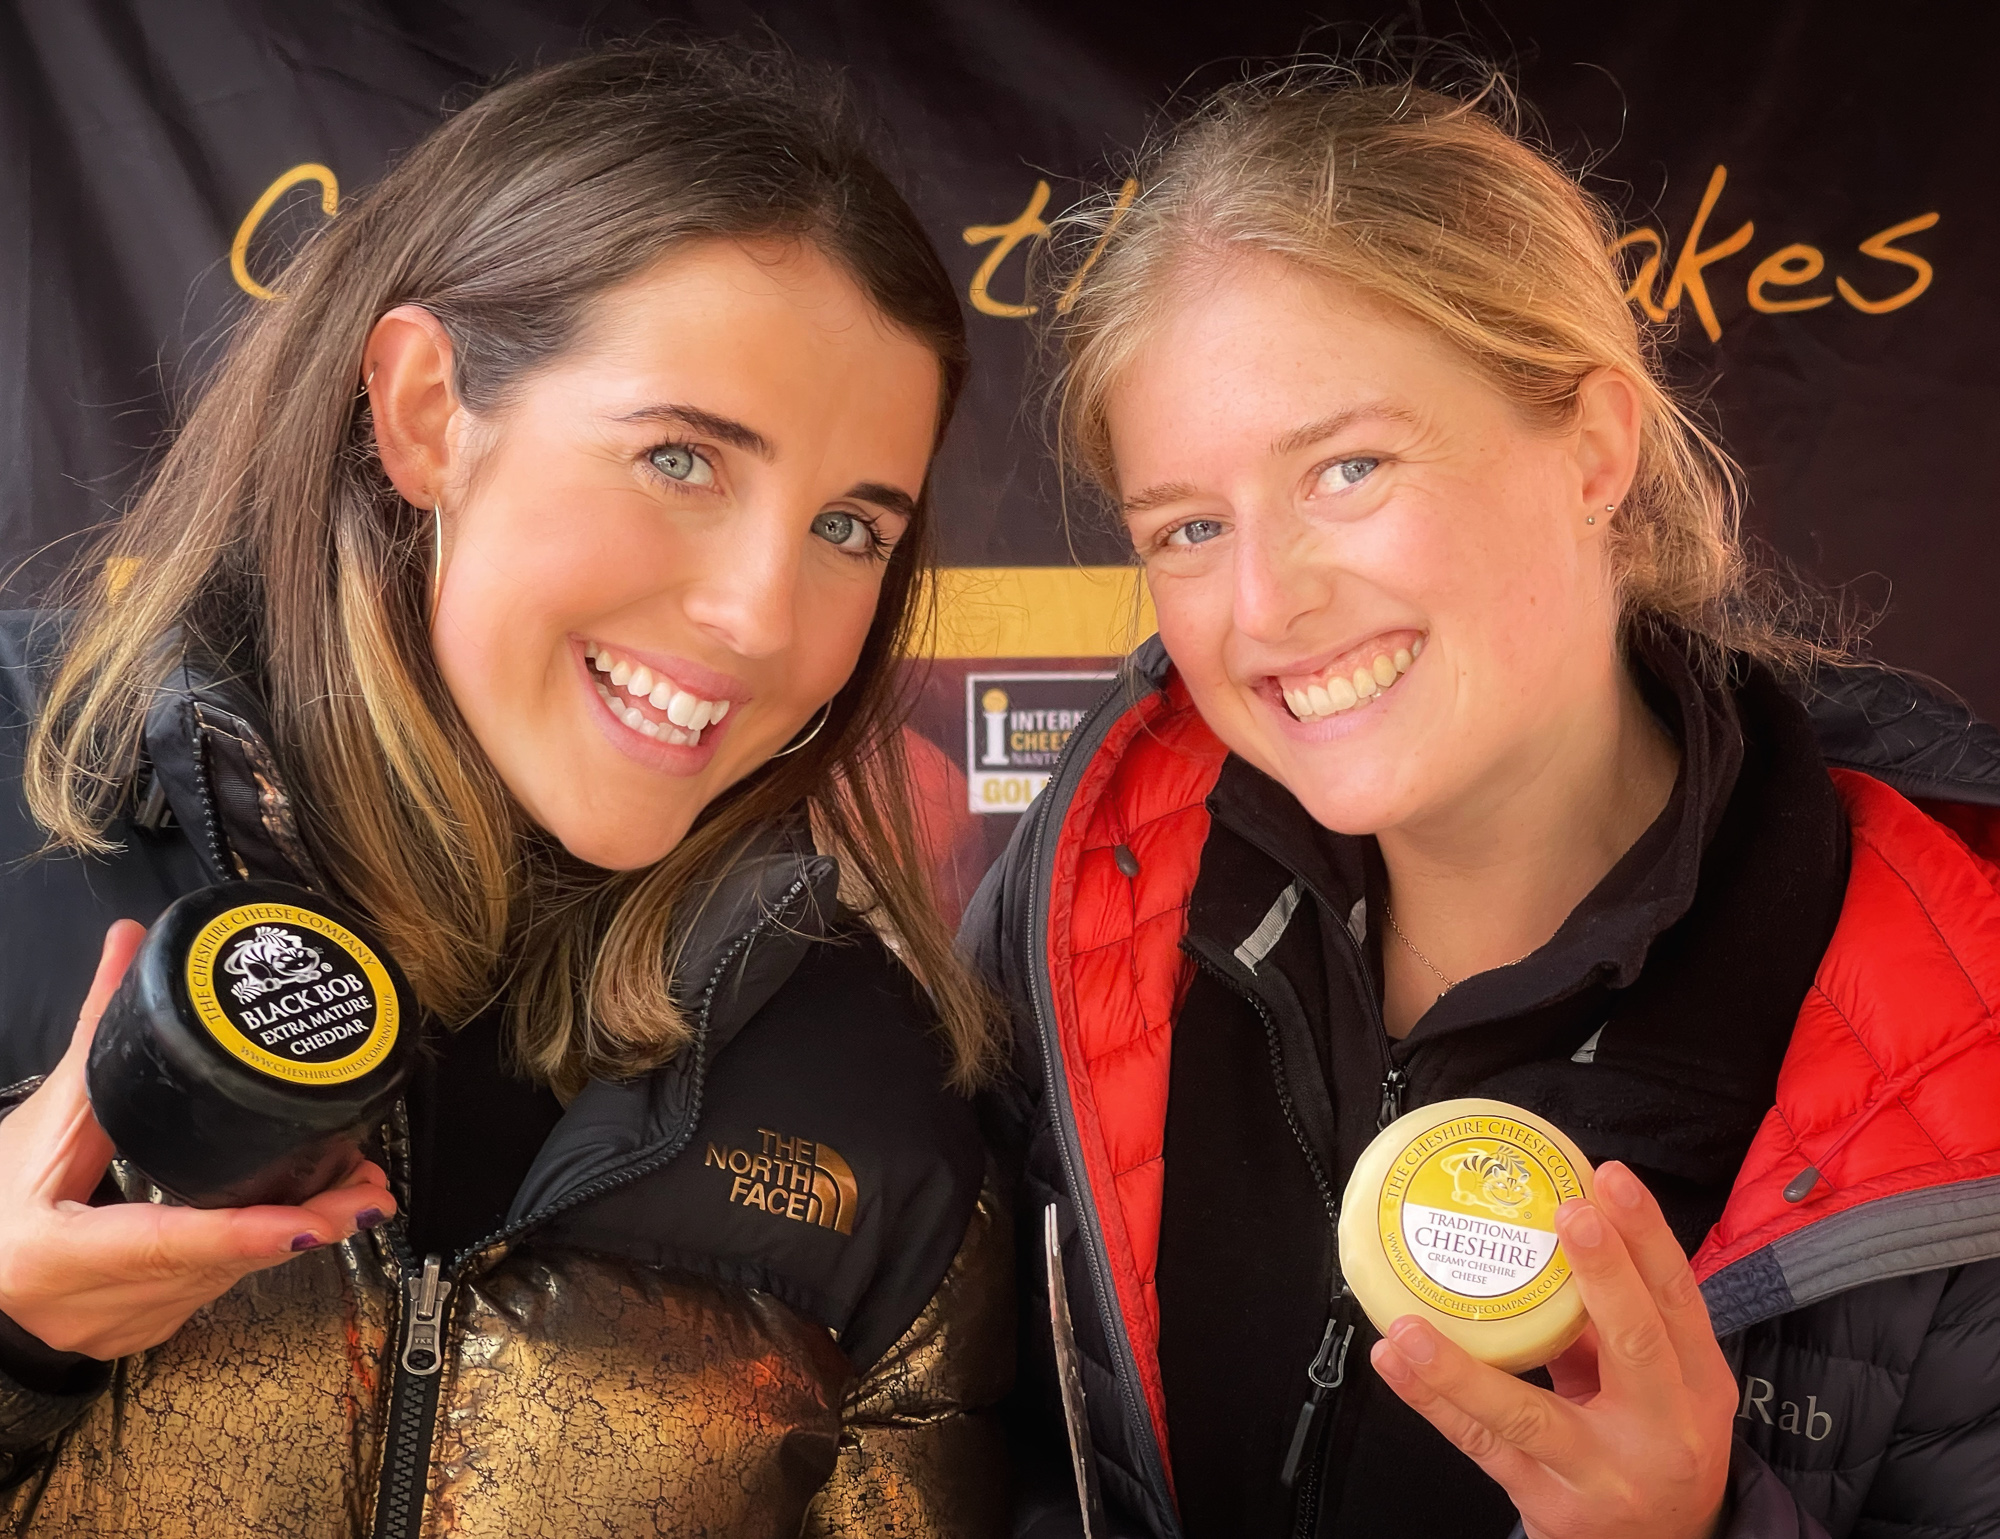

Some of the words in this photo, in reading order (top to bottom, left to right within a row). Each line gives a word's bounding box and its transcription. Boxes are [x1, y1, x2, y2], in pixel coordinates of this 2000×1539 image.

[231, 907, 293, 925] CHEESE
[297, 912, 377, 965] COMPANY
[193, 919, 233, 987] CHESHIRE
[195, 991, 222, 1024] THE
[239, 989, 320, 1030] BLACK
[312, 973, 364, 1003] BOB
[259, 1018, 312, 1046] EXTRA
[308, 995, 373, 1028] MATURE
[289, 1018, 370, 1056] CHEDDAR
[704, 1140, 812, 1194] NORTH
[757, 1127, 814, 1166] THE
[1386, 1166, 1410, 1199] THE
[1405, 1120, 1483, 1166] CHESHIRE
[1488, 1121, 1549, 1156] CHEESE
[729, 1176, 808, 1222] FACE
[1414, 1227, 1538, 1269] CHESHIRE
[1428, 1211, 1531, 1245] TRADITIONAL
[1387, 1232, 1566, 1314] WWW.CHESHIRECHEESECOMPANY.CO.UK
[1427, 1252, 1467, 1269] CREAMY
[1468, 1260, 1516, 1278] CHESHIRE
[1451, 1270, 1488, 1285] CHEESE
[1737, 1374, 1833, 1441] Rab
